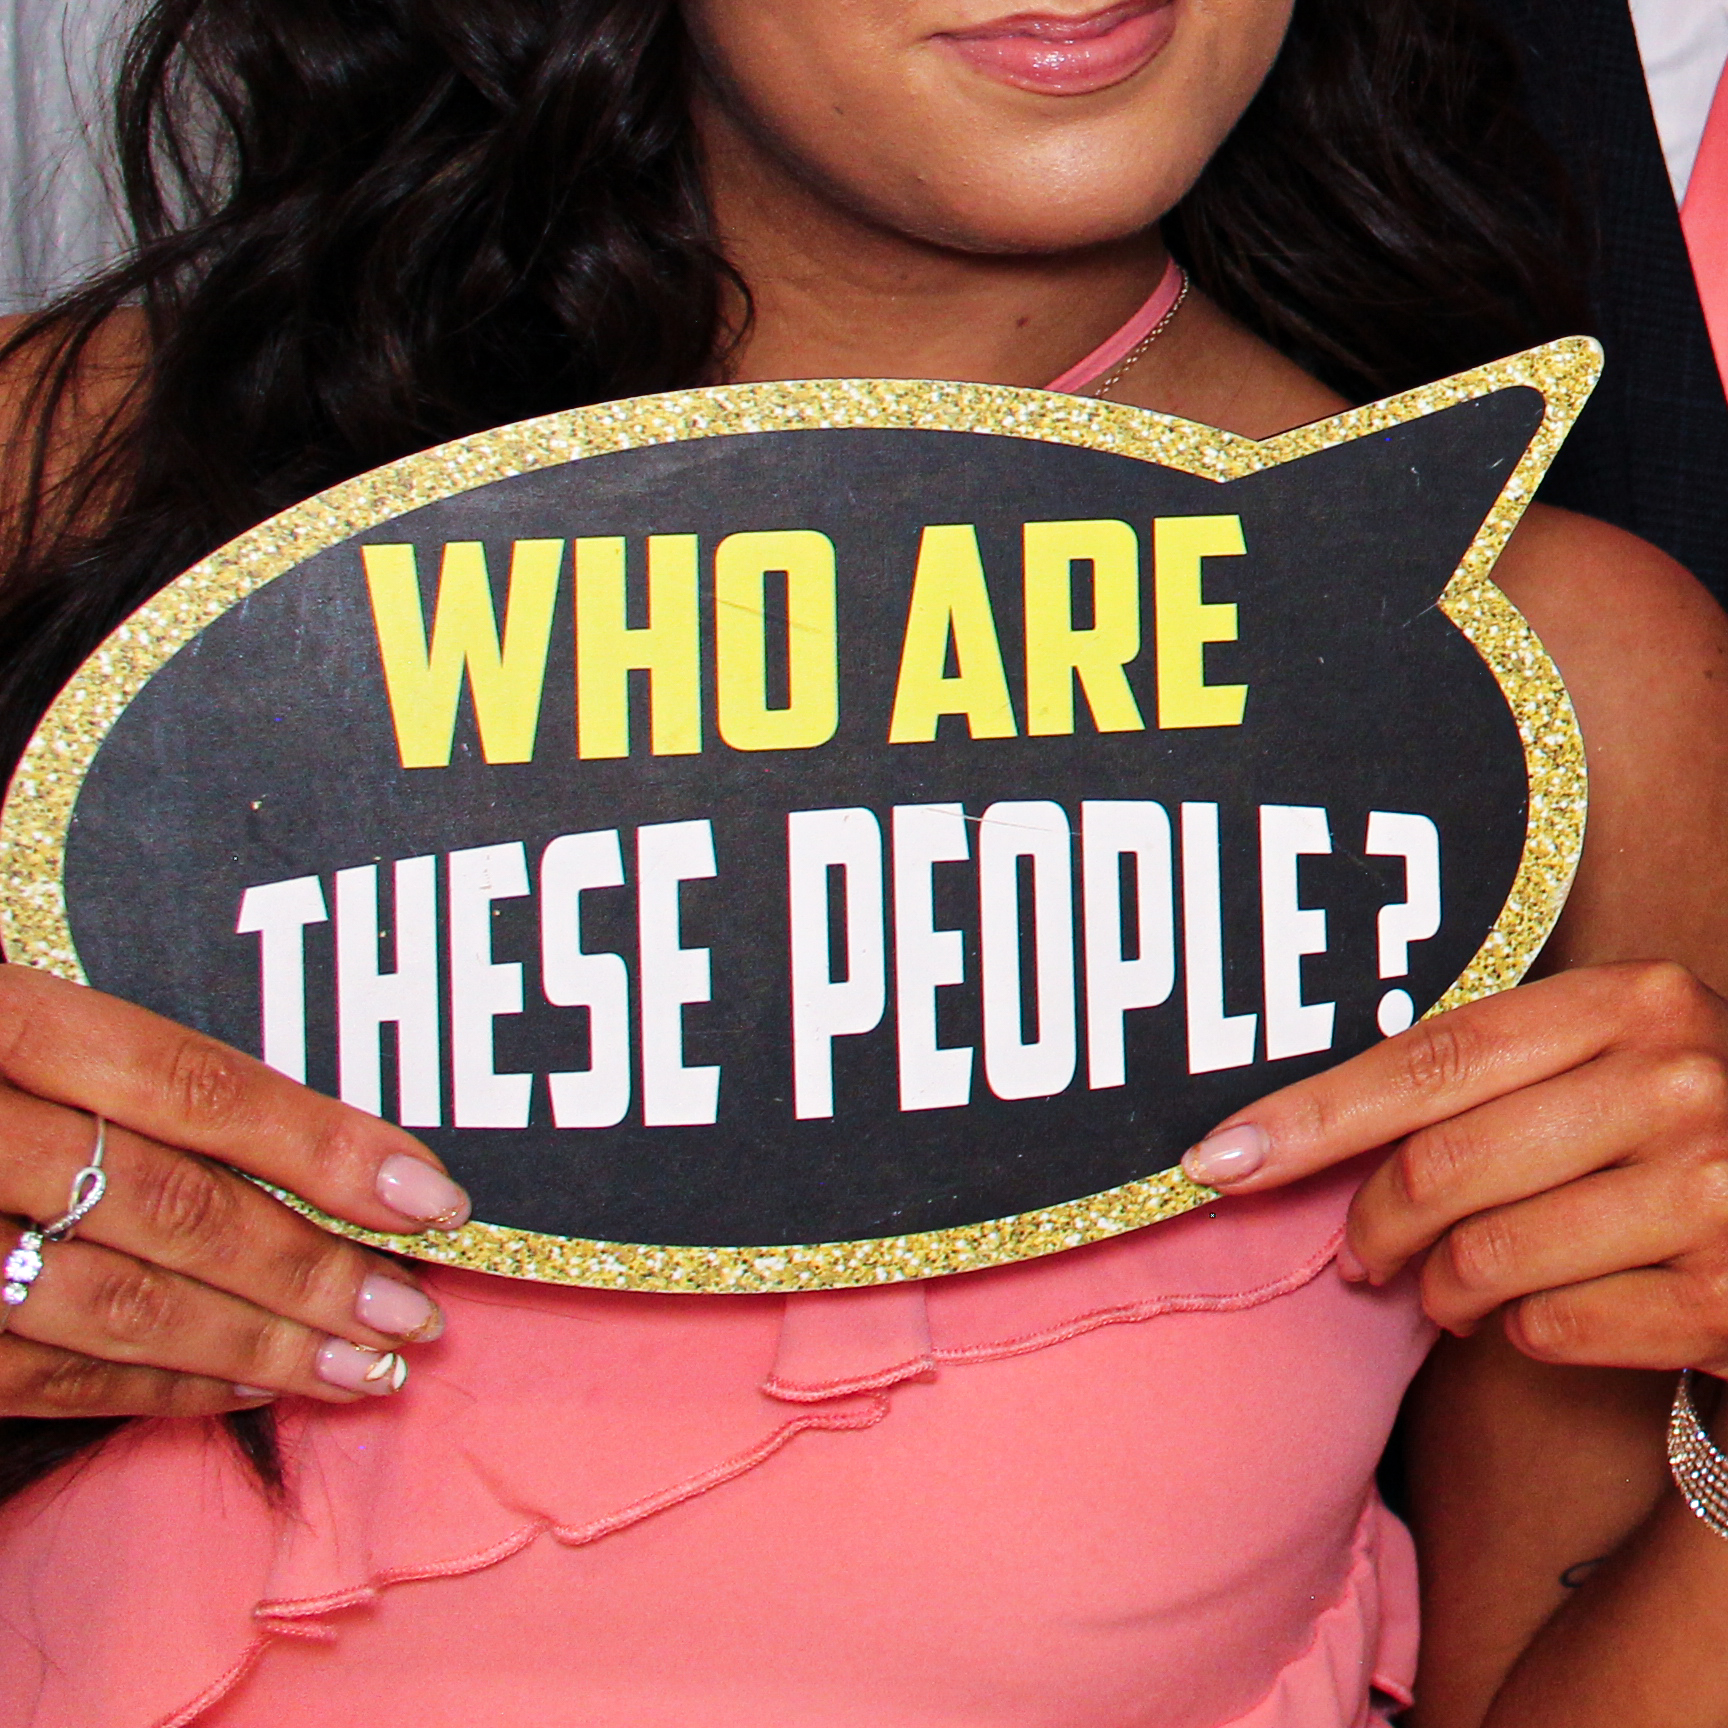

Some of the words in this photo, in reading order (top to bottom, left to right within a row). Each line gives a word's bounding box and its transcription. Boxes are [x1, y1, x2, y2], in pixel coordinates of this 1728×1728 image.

[362, 530, 838, 769] WHO
[888, 515, 1248, 744] ARE
[236, 819, 720, 1129] THESE
